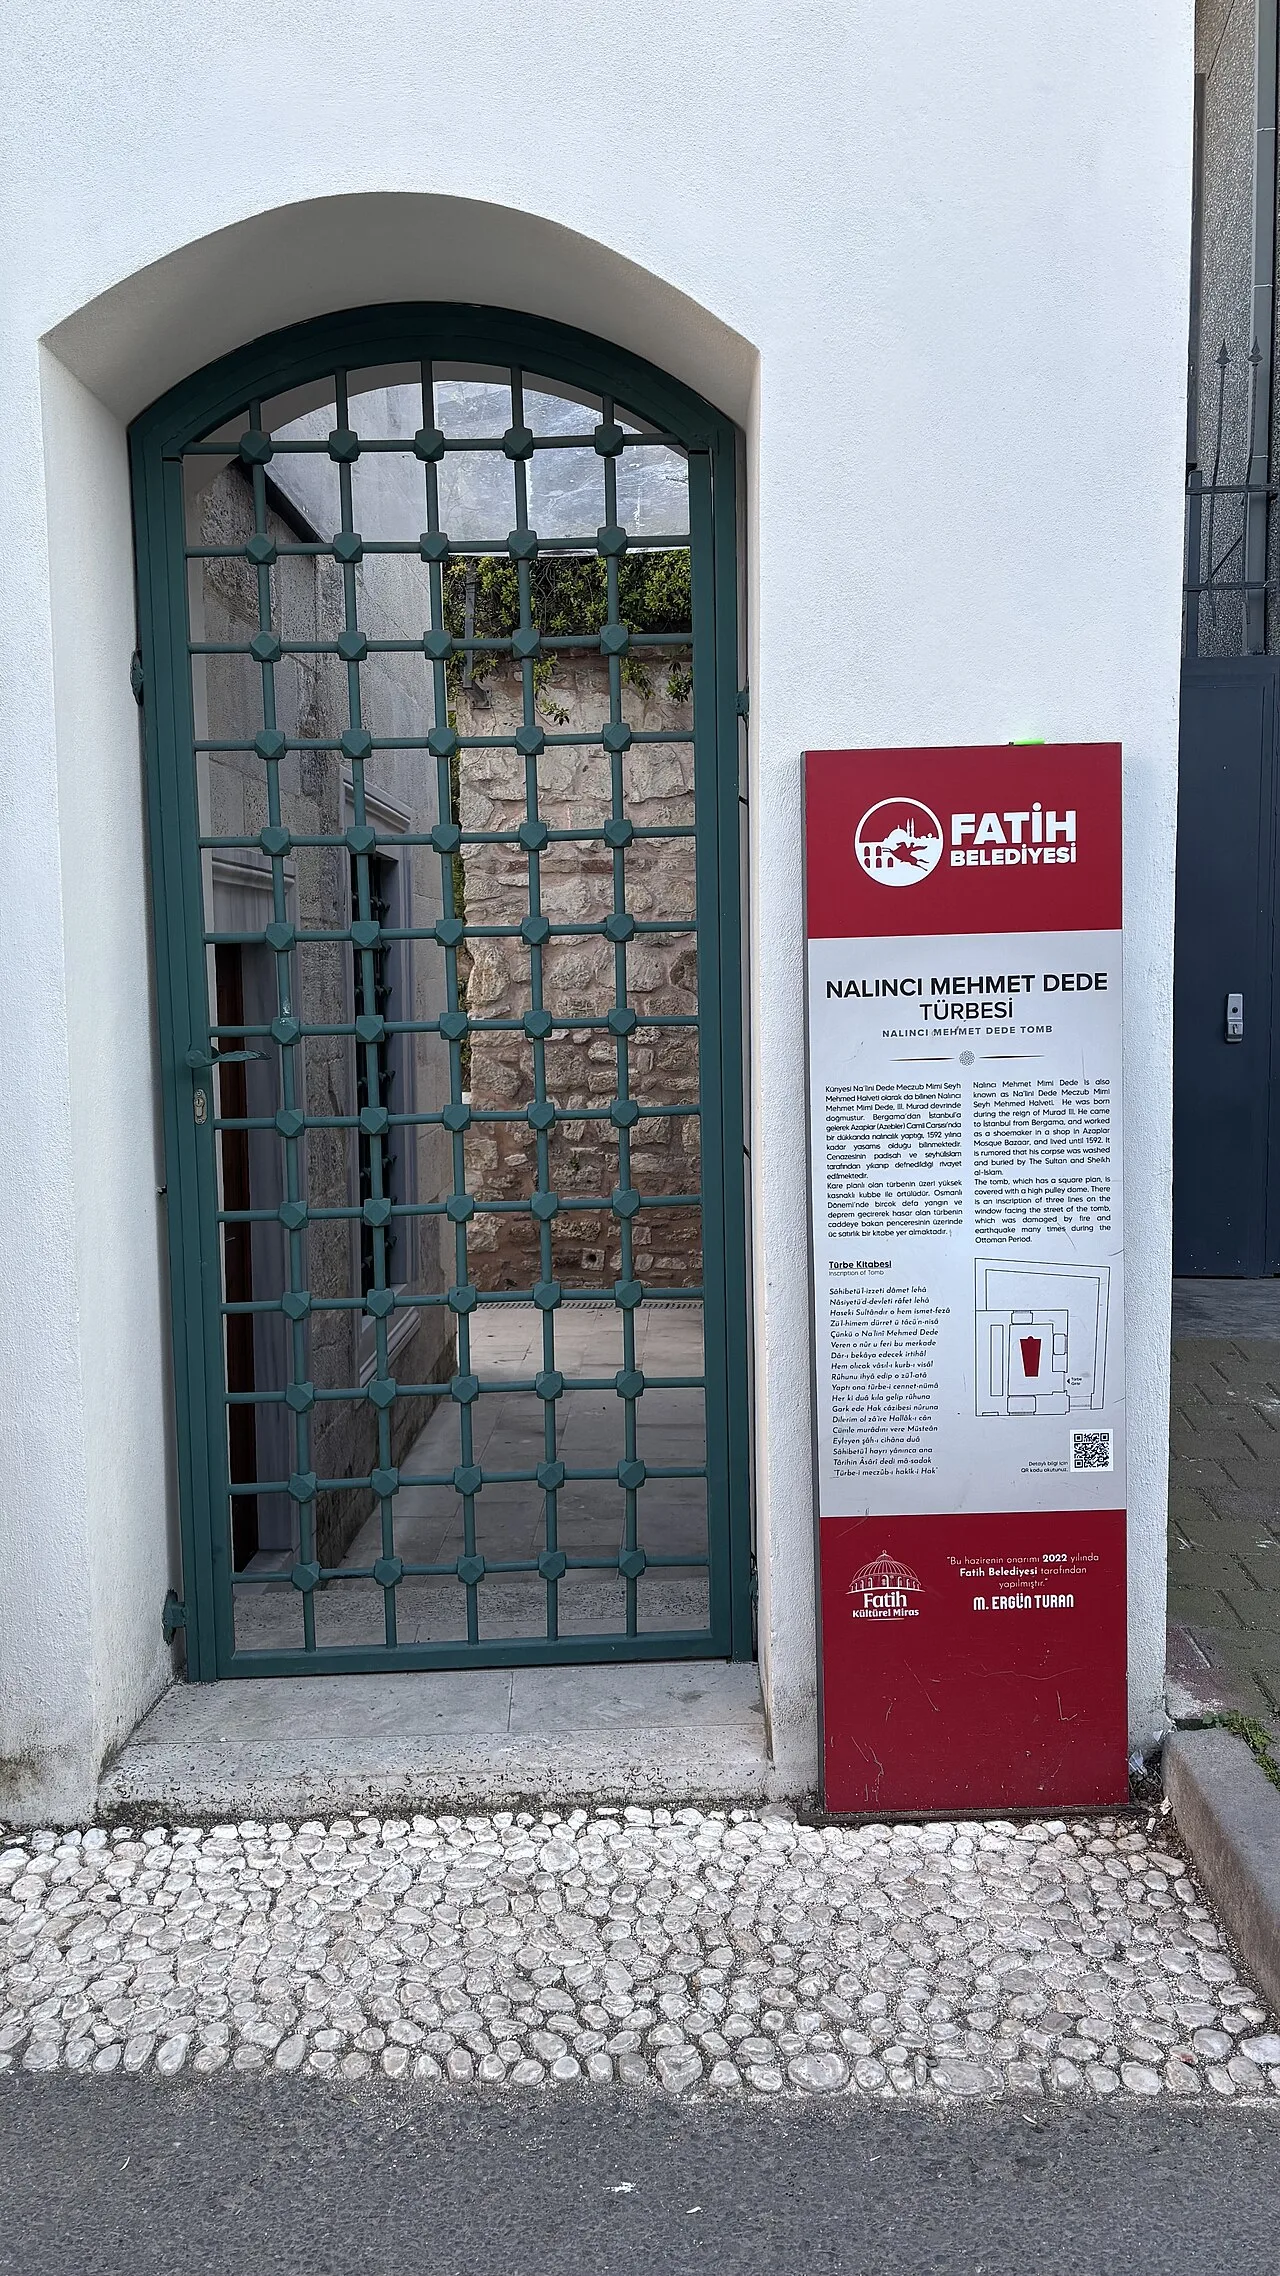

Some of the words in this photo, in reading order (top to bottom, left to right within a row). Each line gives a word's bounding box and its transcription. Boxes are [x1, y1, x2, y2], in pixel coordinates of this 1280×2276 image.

[951, 802, 1076, 845] FATİH
[950, 842, 1076, 867] BELEDİYESİ
[826, 978, 922, 998] NALINCI
[931, 974, 1036, 995] MEHMET
[1043, 973, 1107, 992] DEDE
[919, 997, 1013, 1022] TÜRBESİ
[882, 1029, 928, 1037] NALINCI
[931, 1025, 981, 1036] MEHMET
[986, 1026, 1016, 1034] DEDE
[1020, 1025, 1052, 1033] TOMB
[1038, 1089, 1057, 1097] Dede
[973, 1111, 996, 1119] during
[1012, 1110, 1031, 1118] reign
[1083, 1117, 1110, 1125] worked
[993, 1129, 1033, 1137] shoemaker
[1052, 1128, 1071, 1136] shop
[1040, 1148, 1065, 1156] corpse
[1082, 1146, 1111, 1154] washed
[973, 1159, 988, 1167] and
[1017, 1158, 1026, 1166] by
[1045, 1157, 1068, 1165] Sultan
[974, 1178, 988, 1186] The
[1012, 1177, 1034, 1185] which
[974, 1188, 1003, 1196] covered
[1027, 1187, 1043, 1195] high
[1044, 1186, 1066, 1195] pulley
[1090, 1185, 1111, 1193] There
[1034, 1196, 1043, 1204] of
[1004, 1207, 1027, 1215] facing
[1065, 1205, 1074, 1213] of
[1022, 1216, 1058, 1224] damaged
[1063, 1215, 1073, 1223] by
[974, 1226, 1016, 1235] earthquake
[1071, 1225, 1094, 1233] during
[975, 1236, 1007, 1244] Ottoman
[1008, 1235, 1032, 1243] Period.
[965, 1556, 1004, 1565] hazirenin
[1042, 1553, 1068, 1563] 2022
[1070, 1552, 1099, 1563] yılında
[960, 1567, 985, 1577] Fatih
[988, 1566, 1038, 1578] Belediyesi
[1041, 1564, 1087, 1575] tarafından
[864, 1592, 907, 1608] Fatih
[853, 1608, 891, 1618] Kültürel
[893, 1608, 919, 1617] Miras
